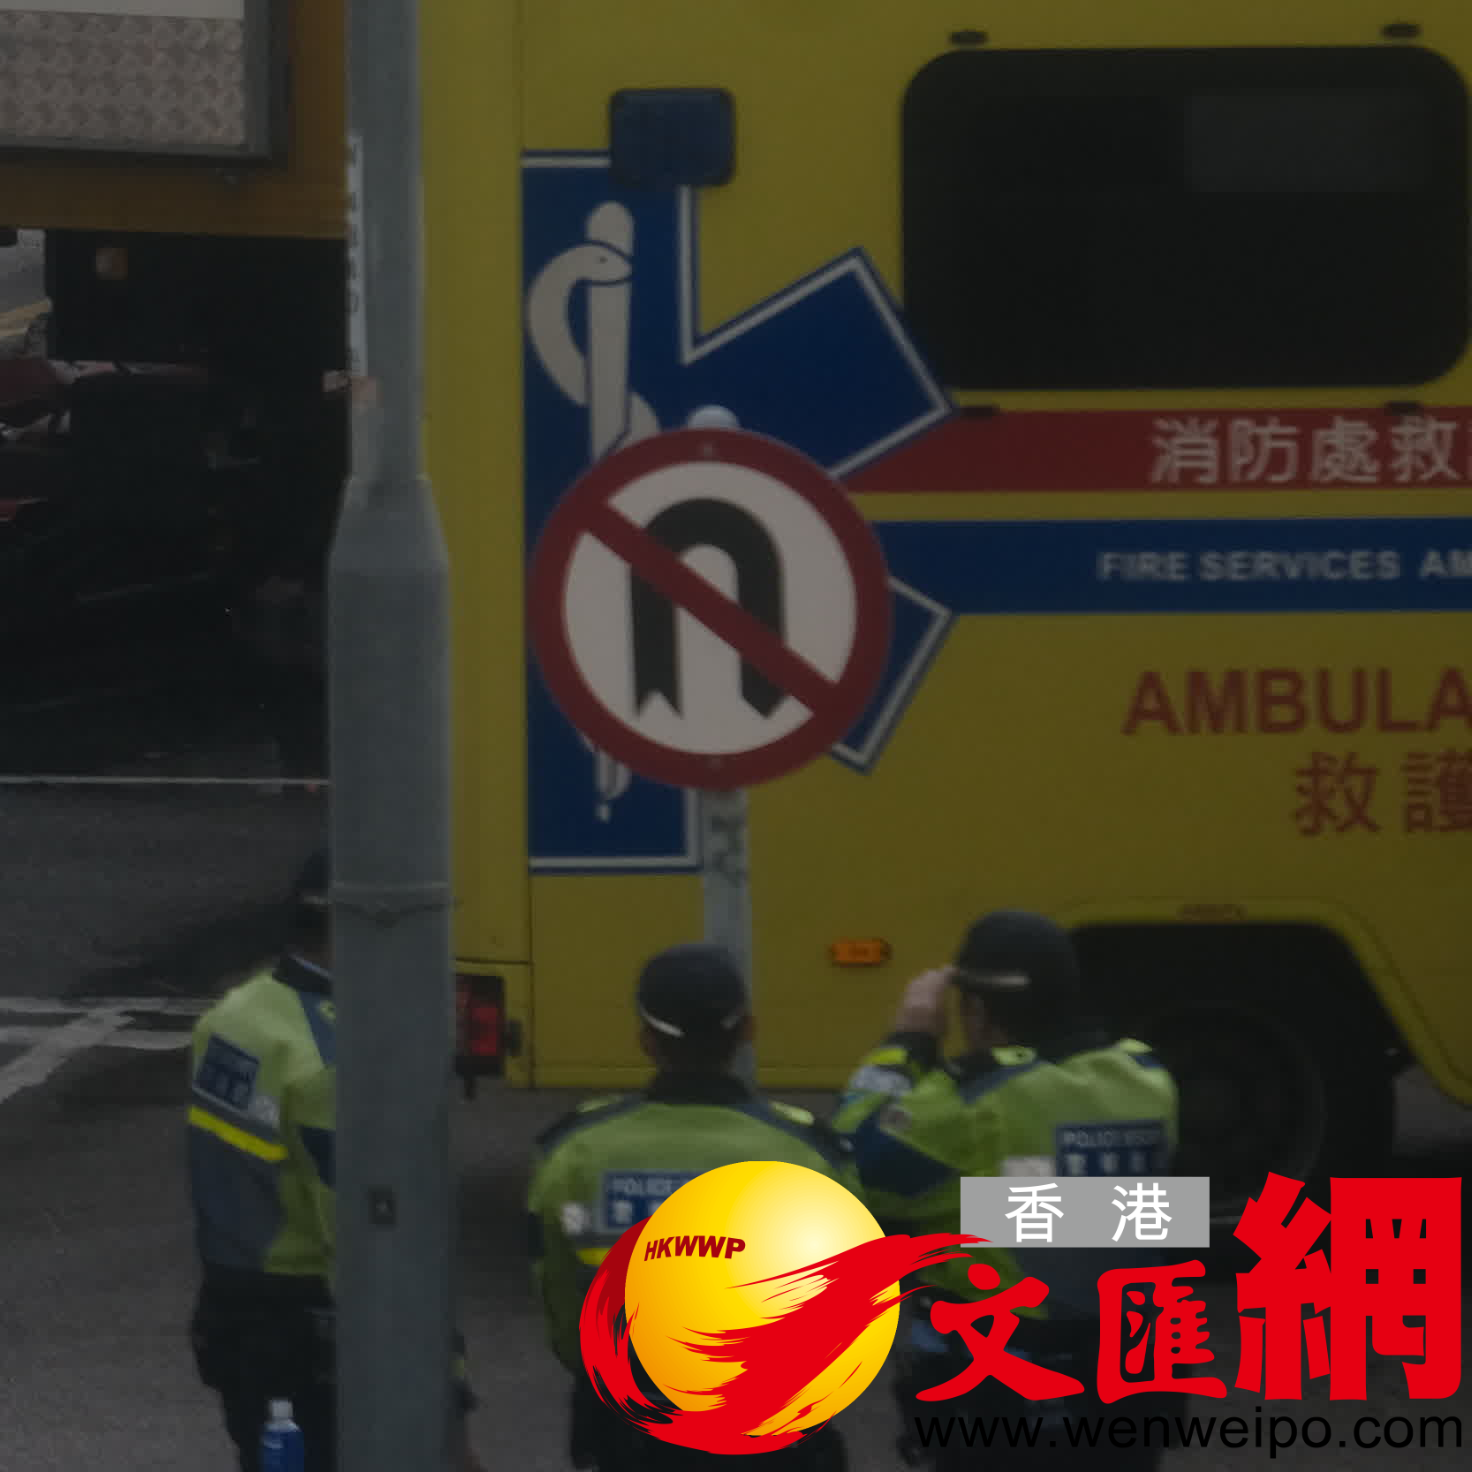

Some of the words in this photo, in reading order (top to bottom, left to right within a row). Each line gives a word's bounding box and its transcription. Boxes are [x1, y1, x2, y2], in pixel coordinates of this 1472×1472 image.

[1150, 416, 1472, 485] 消防處救
[1097, 551, 1190, 582] FIRE
[1199, 549, 1399, 582] SERVICES
